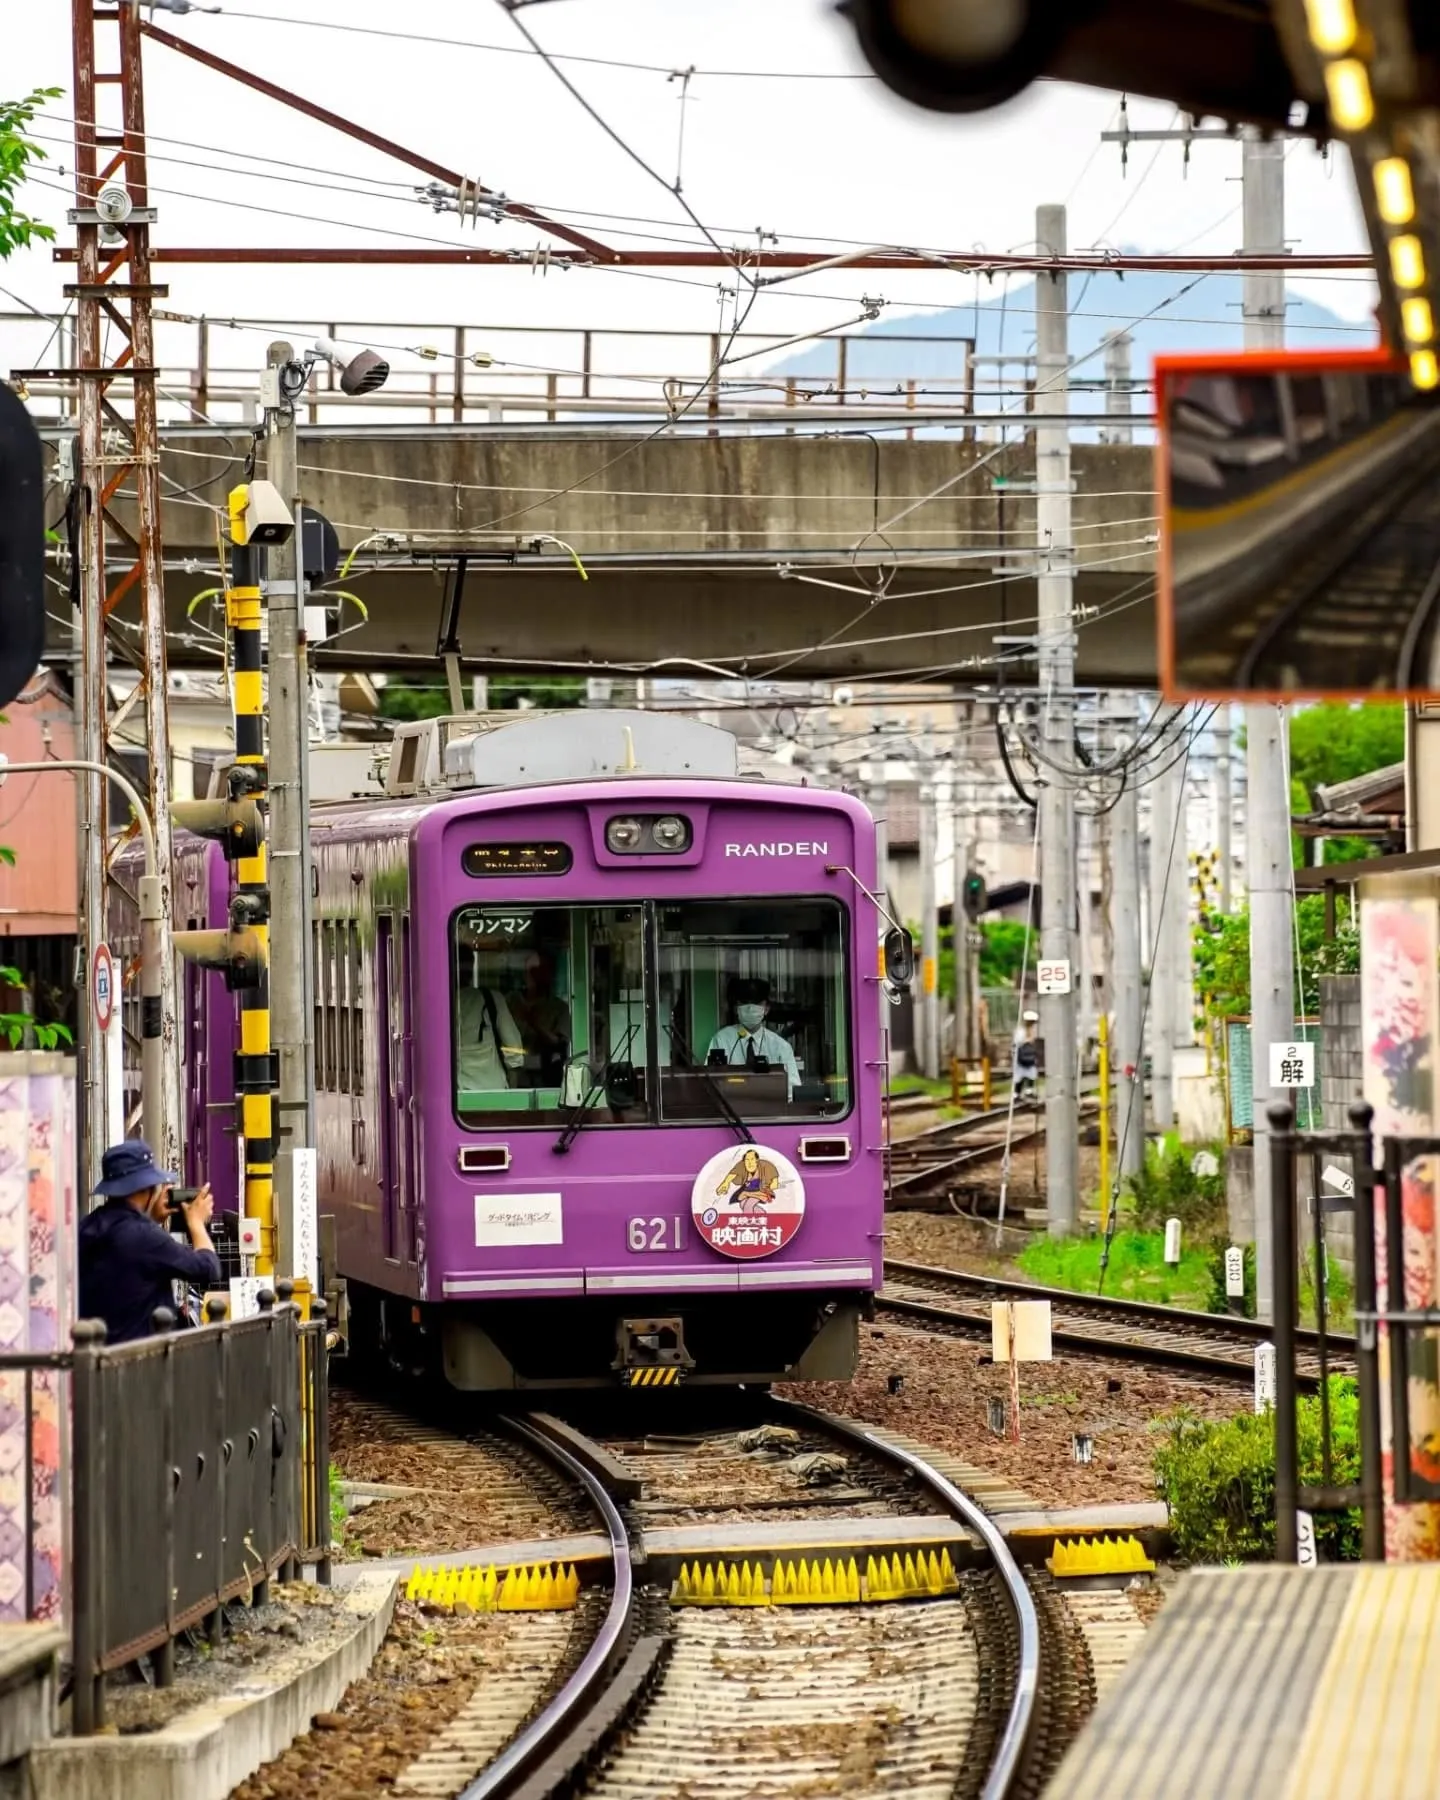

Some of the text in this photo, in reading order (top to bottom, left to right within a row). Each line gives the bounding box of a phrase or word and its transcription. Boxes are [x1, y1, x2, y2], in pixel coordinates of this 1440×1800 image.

[725, 842, 828, 857] RANDEN
[469, 919, 532, 934] ワンマン
[1040, 967, 1066, 981] 25
[1287, 1046, 1297, 1058] 2
[1281, 1059, 1304, 1083] 解
[629, 1217, 681, 1250] 621
[712, 1226, 783, 1246] 映画村
[1228, 1254, 1242, 1281] 300
